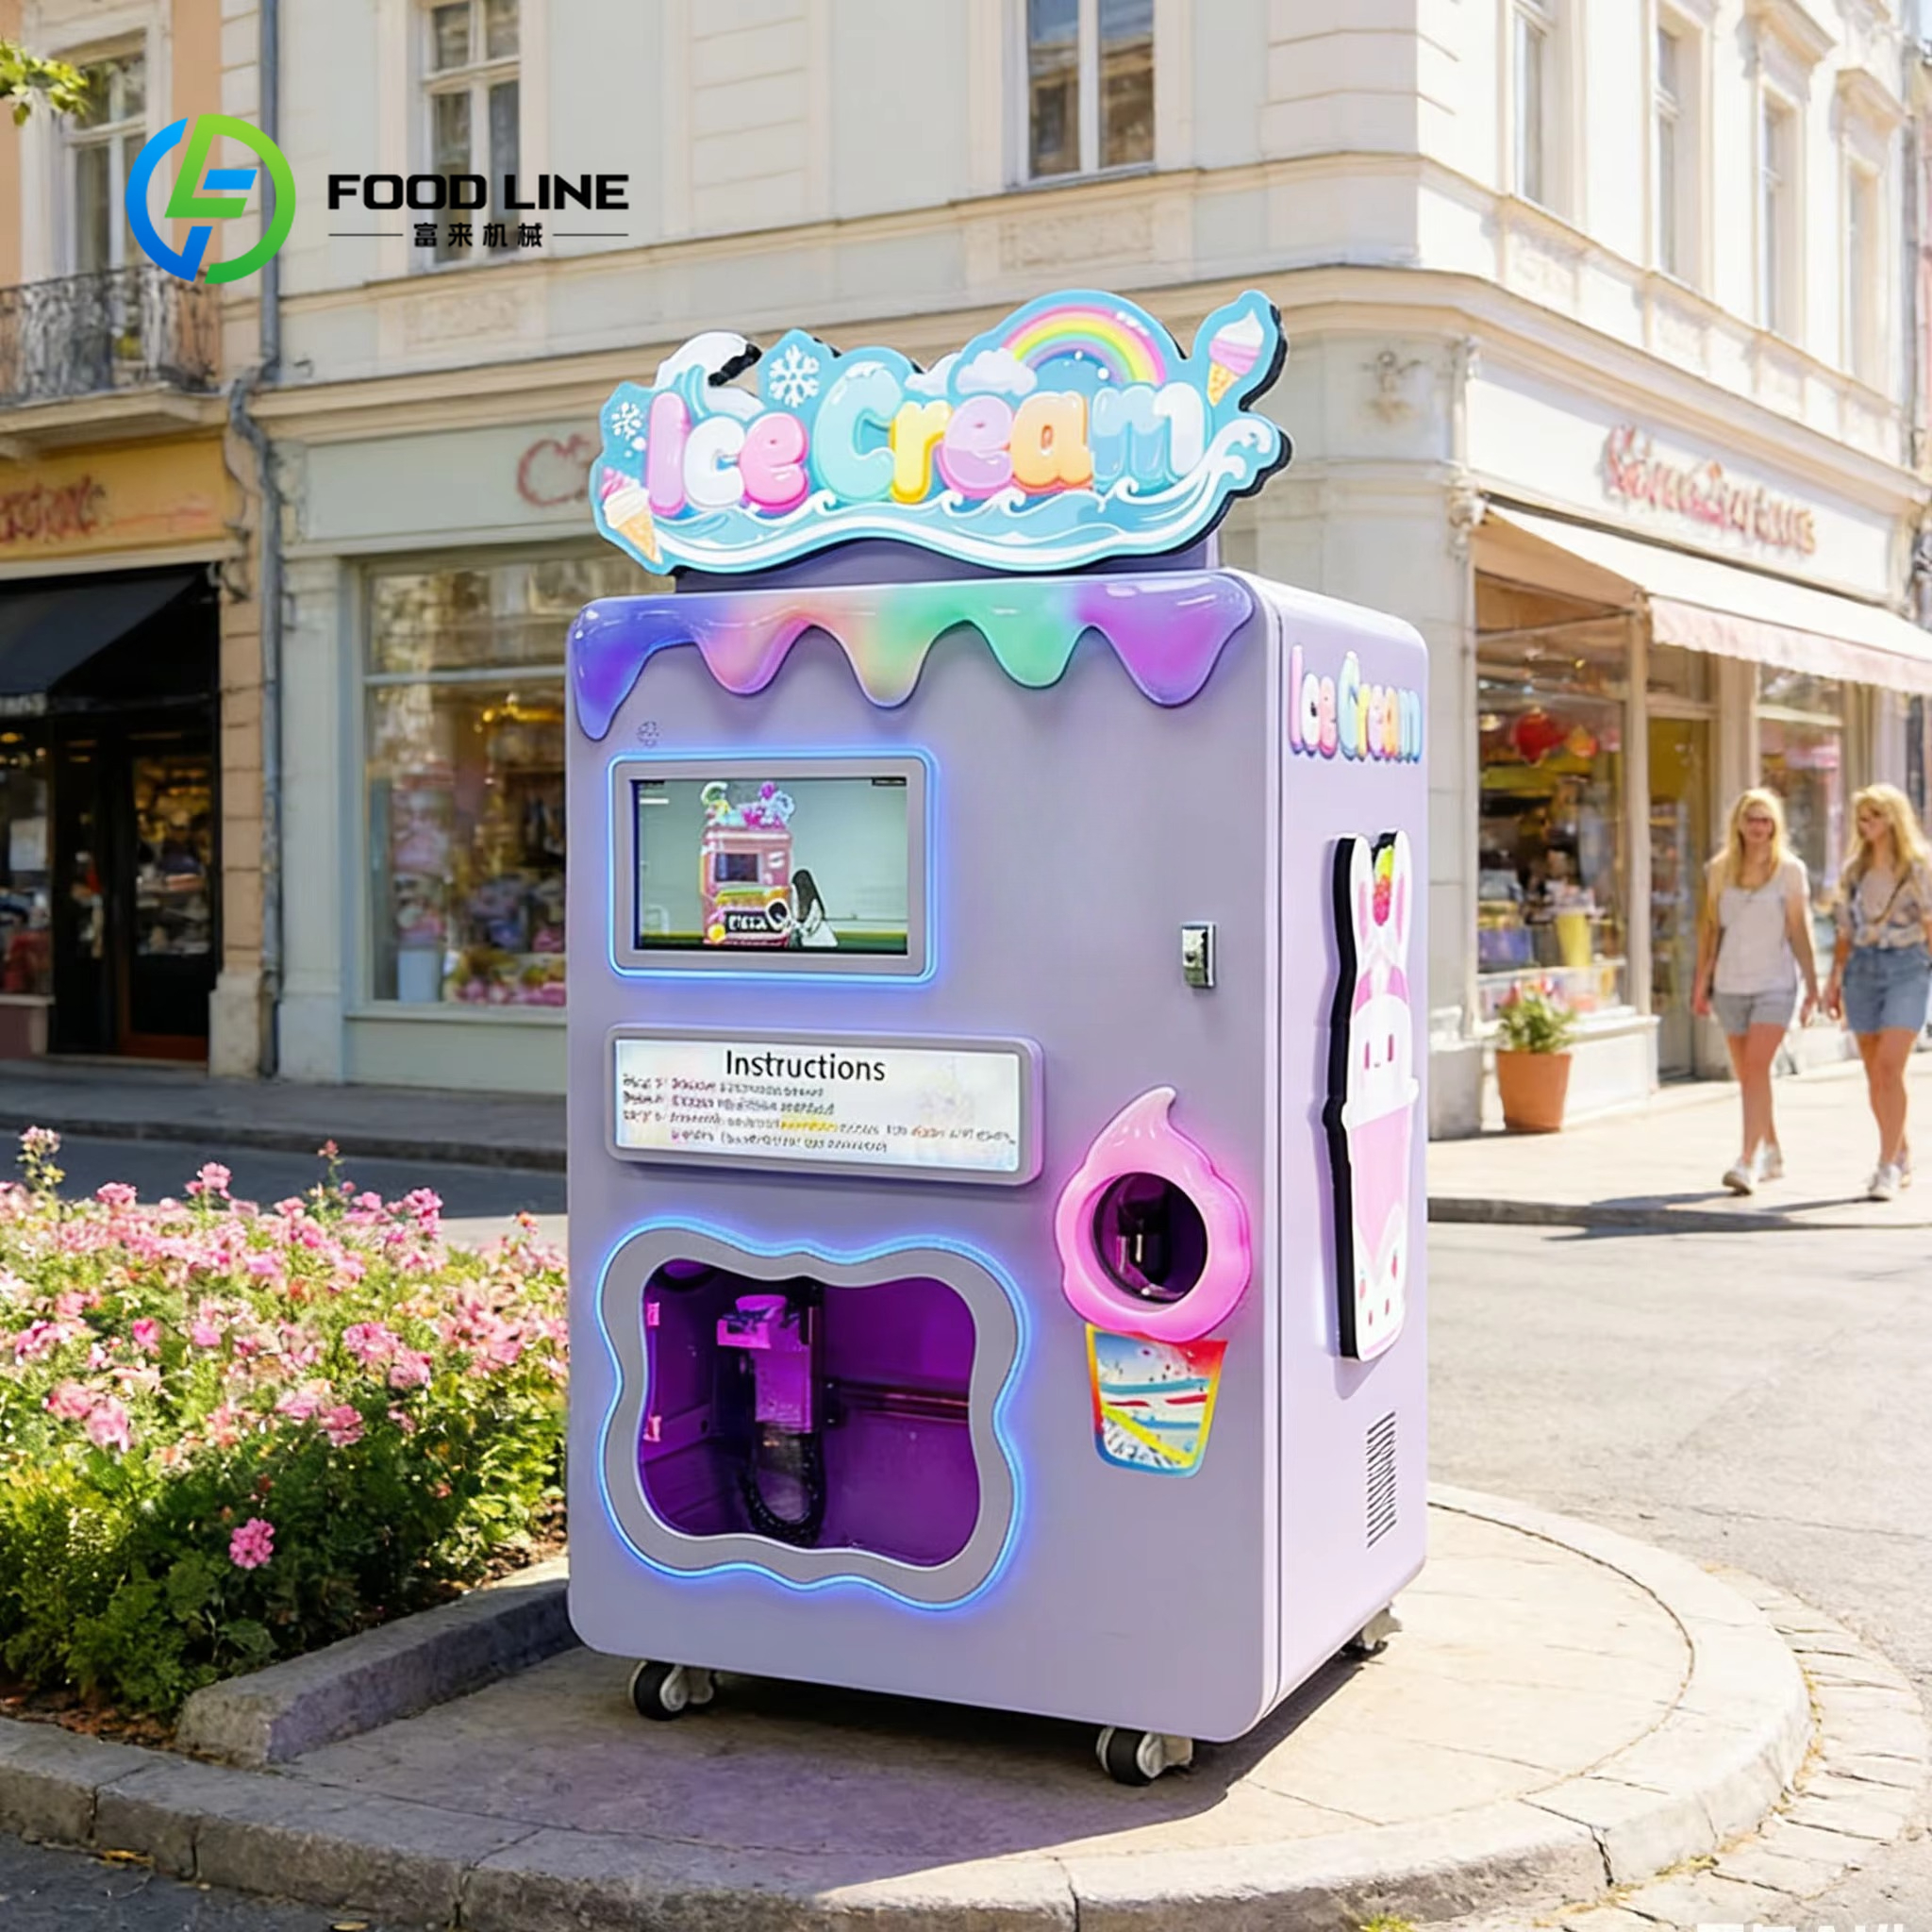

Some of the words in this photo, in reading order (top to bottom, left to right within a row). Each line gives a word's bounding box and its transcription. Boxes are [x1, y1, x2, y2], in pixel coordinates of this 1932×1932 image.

[645, 391, 808, 516] Ice
[811, 360, 1208, 504] Cream
[724, 1049, 886, 1082] Instructions
